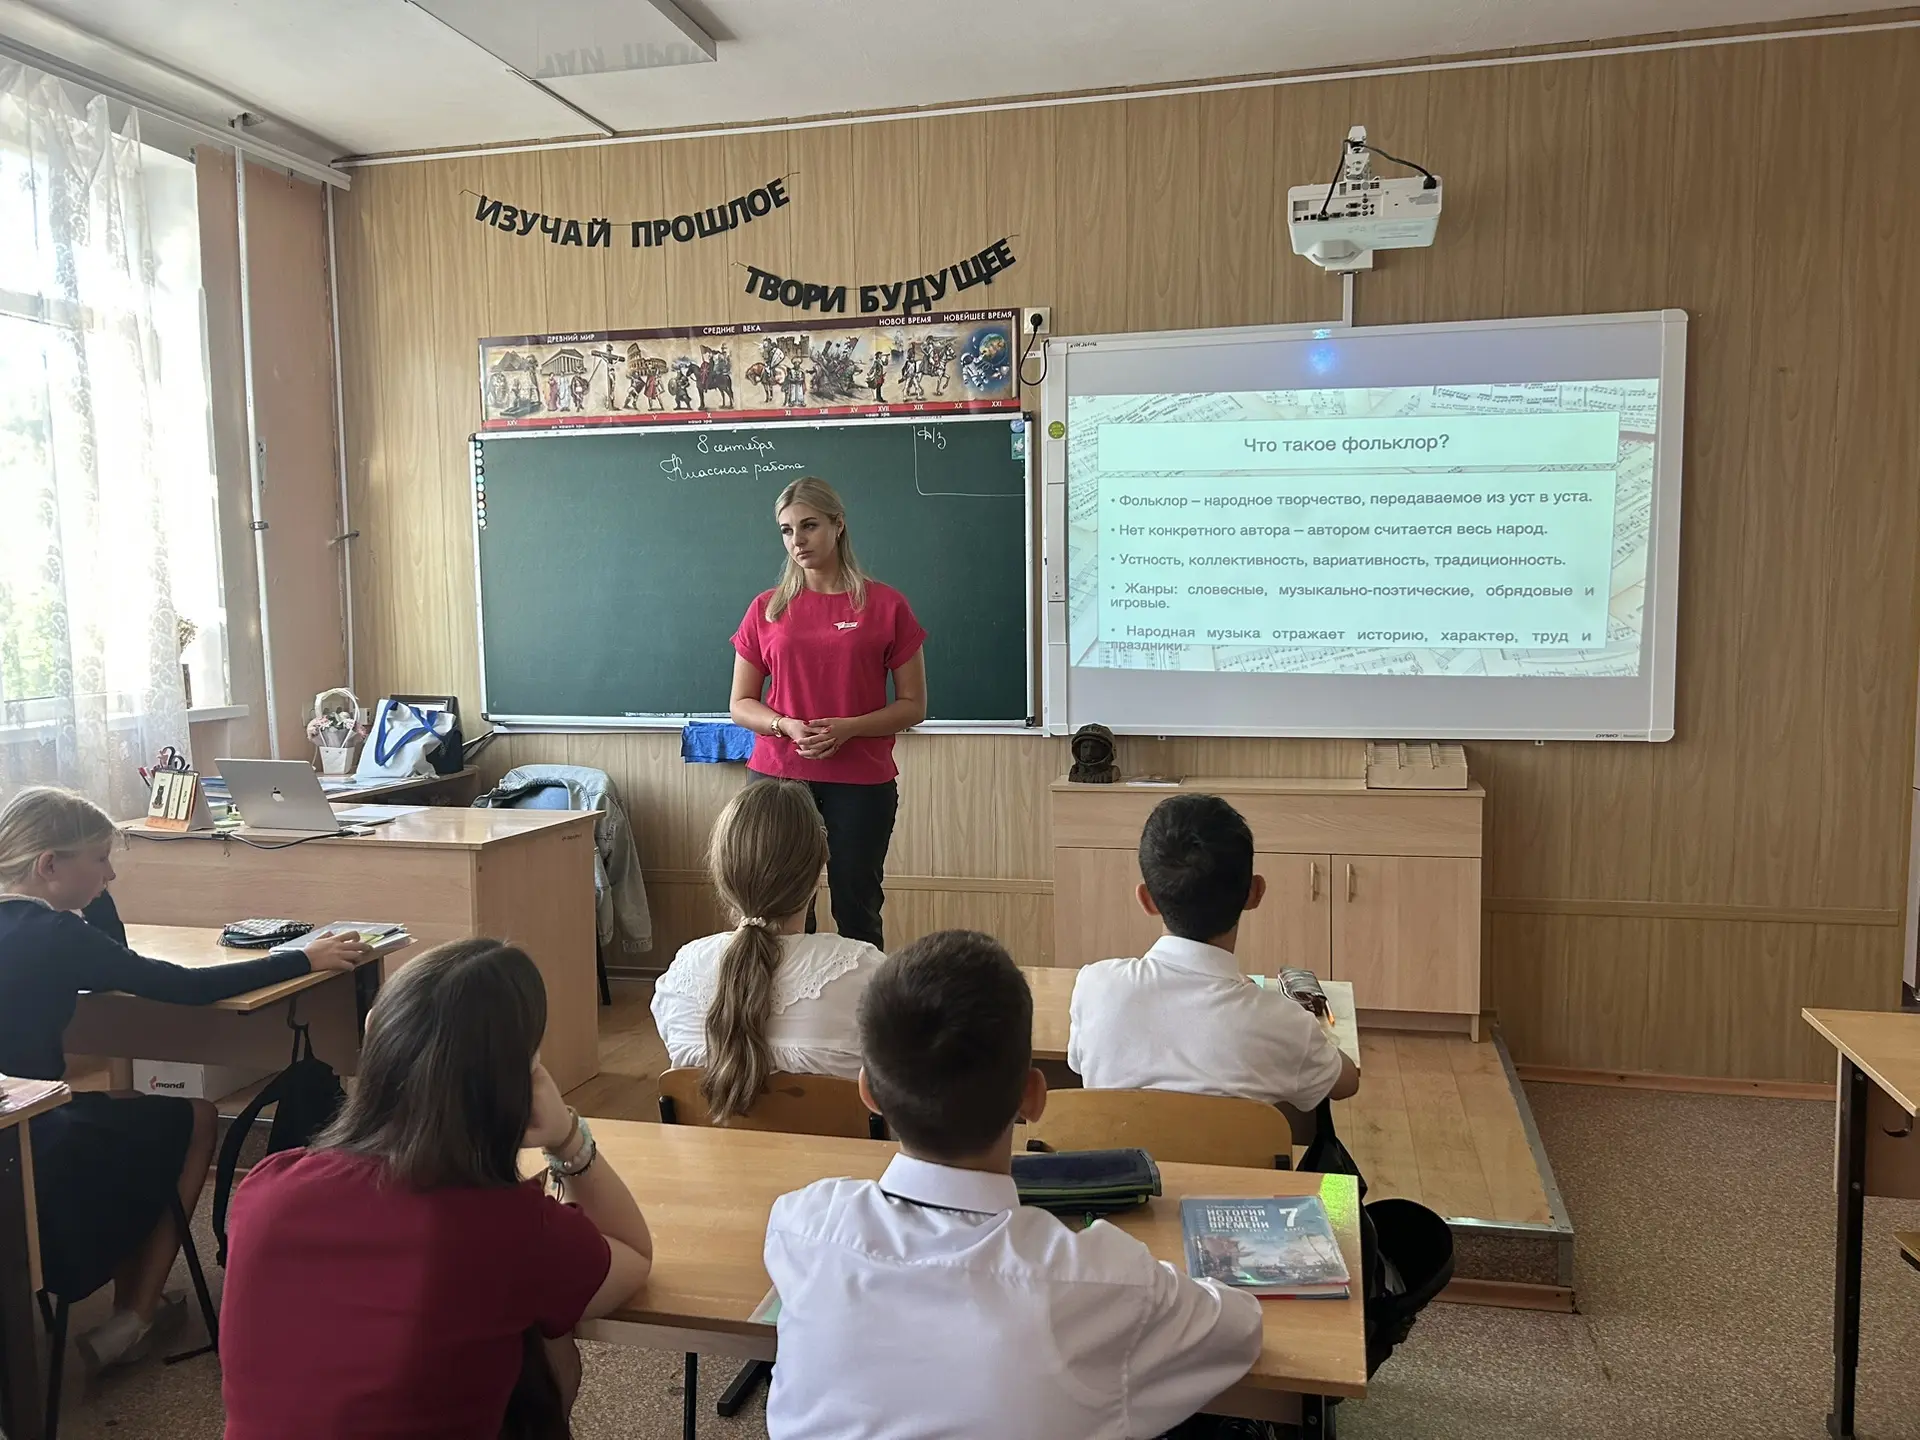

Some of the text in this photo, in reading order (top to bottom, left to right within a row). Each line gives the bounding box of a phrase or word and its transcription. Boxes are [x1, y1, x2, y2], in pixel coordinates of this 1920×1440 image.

[475, 178, 790, 248] ИЗУЧАЙ ПРОШЛОЕ
[744, 238, 1016, 314] ТВОРИ БУДУЩЕЕ
[879, 316, 932, 326] НОВОЕ ВРЕМЯ
[943, 311, 1013, 322] НОВЕЙШЕЕ ВРЕМЯ
[547, 333, 595, 344] ДРЕВНИЙ МИР
[703, 325, 762, 335] СРЕДНИЕ ВЕКА
[697, 434, 709, 454] 8
[1244, 433, 1450, 455] Что такое фольклор?
[660, 454, 805, 481] Классная работа
[1119, 494, 1188, 509] Фольклор
[1204, 496, 1273, 509] народное
[1276, 495, 1366, 509] творчество,
[1369, 493, 1483, 508] передаваемое
[1486, 493, 1506, 504] из
[1509, 493, 1536, 507] уст
[1539, 493, 1549, 503] в
[1552, 492, 1593, 506] уста.
[1119, 524, 1146, 536] Нет
[1148, 526, 1237, 539] конкретного
[1239, 526, 1291, 539] автора
[1307, 526, 1370, 539] автором
[1373, 525, 1453, 536] считается
[1456, 524, 1493, 535] весь
[1496, 524, 1548, 538] народ.
[1119, 553, 1566, 569] Устность, коллективность, вариативность, традиционность.
[1124, 582, 1595, 600] Жанры: словесные, музыкально-поэтические, обрядовые и
[1110, 598, 1170, 611] игровые.
[1126, 624, 1592, 645] Народная музыка отражает историю, характер, труд и
[155, 1081, 185, 1089] mondi
[1279, 1208, 1298, 1227] 7
